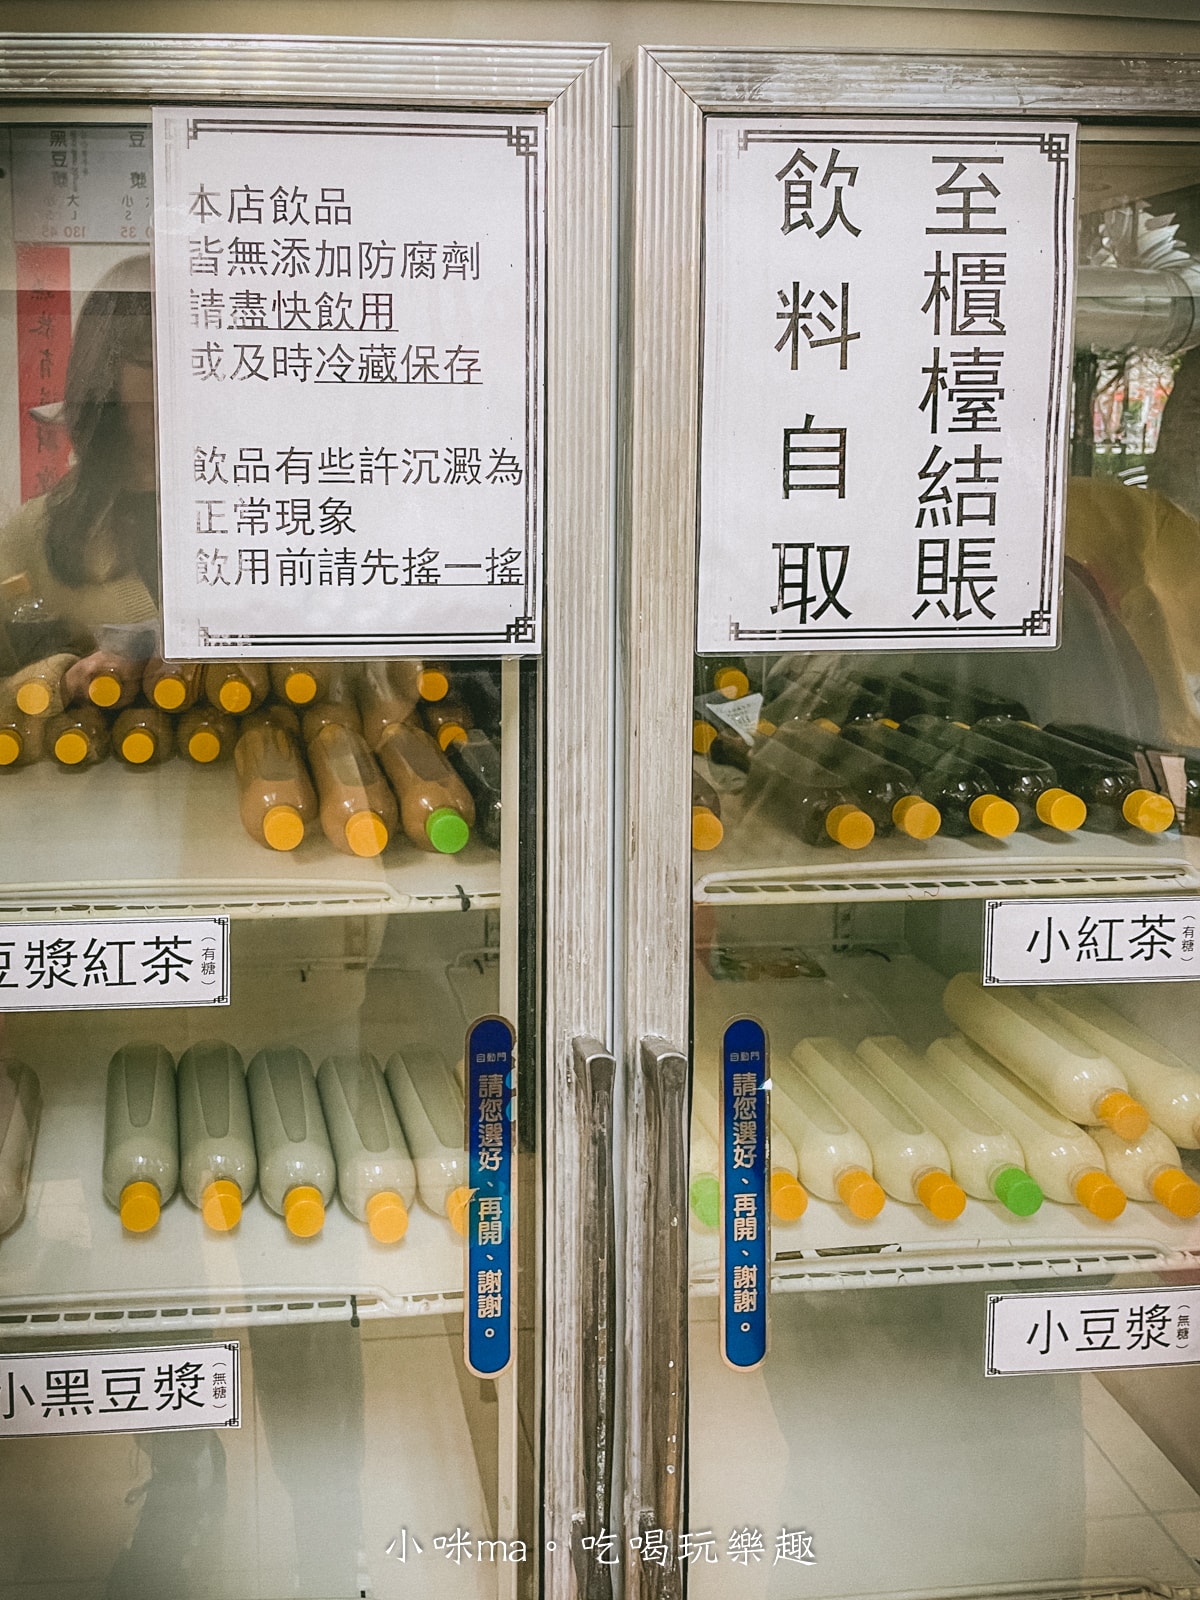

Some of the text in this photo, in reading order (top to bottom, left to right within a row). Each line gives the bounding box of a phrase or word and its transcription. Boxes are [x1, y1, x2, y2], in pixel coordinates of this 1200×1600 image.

[187, 183, 353, 226] 本店飲品
[187, 234, 481, 281] 皆無添加防腐劑
[189, 287, 395, 331] 請盡快飲用
[191, 340, 482, 383] 或及時冷藏保存
[770, 147, 862, 625] 飲料自取
[911, 155, 1007, 621] 至櫃檯結賬
[193, 445, 524, 486] 飲品有些許沉澱為
[195, 495, 357, 537] 正常現象
[196, 546, 524, 587] 飲用前請先搖一搖
[1026, 914, 1177, 963] 小紅茶
[201, 936, 216, 986] （有糖）
[476, 1052, 507, 1063] 自動門
[729, 1051, 760, 1062] 自動門
[1026, 1303, 1172, 1355] 小豆漿
[0, 1361, 205, 1420] 小黑豆漿
